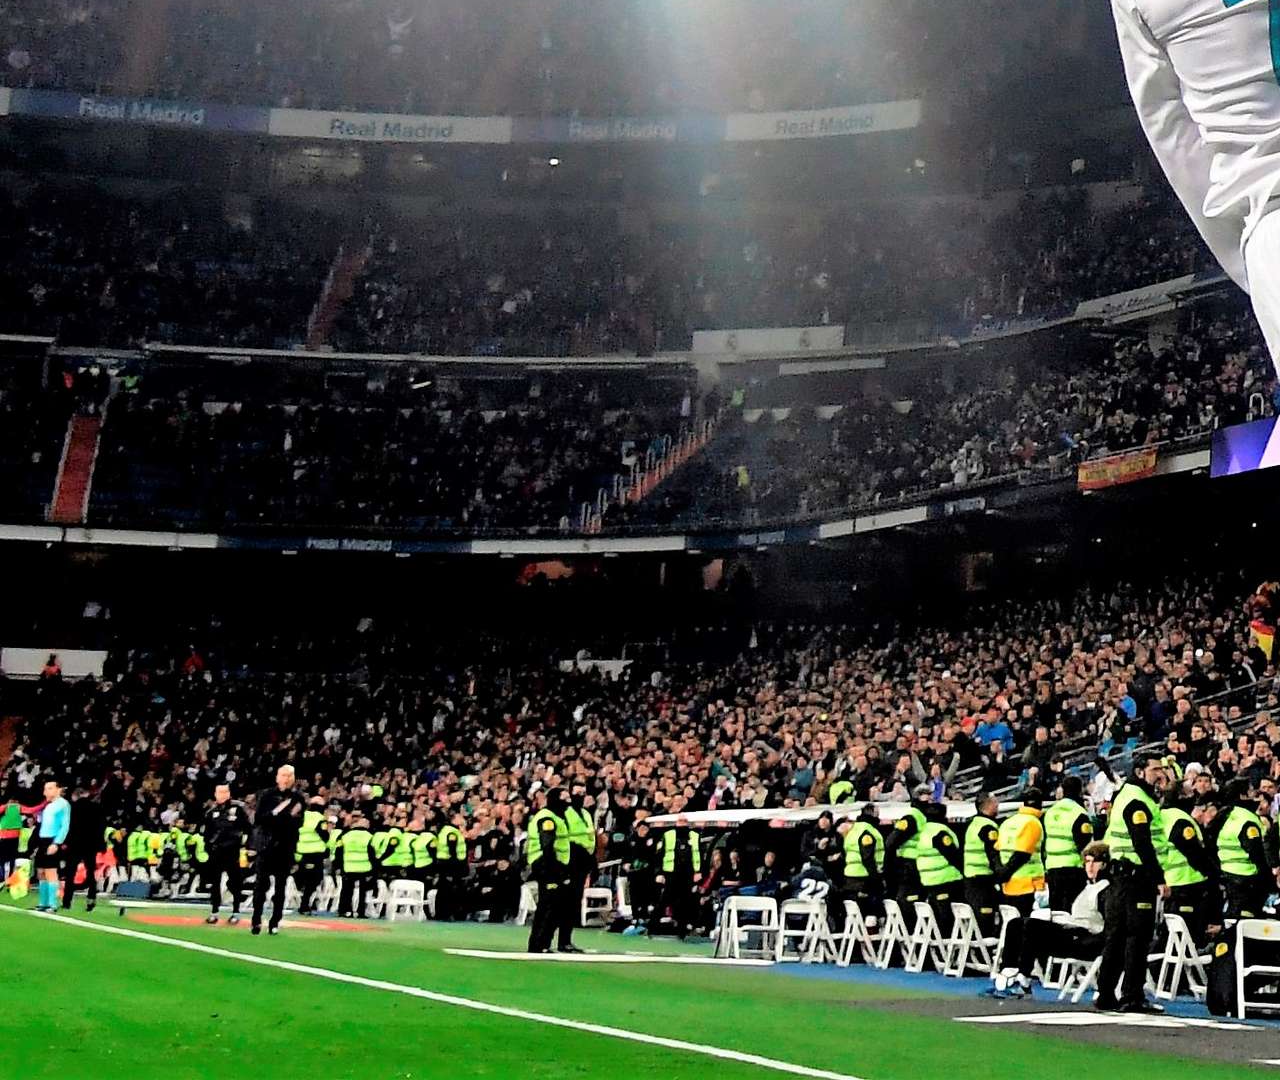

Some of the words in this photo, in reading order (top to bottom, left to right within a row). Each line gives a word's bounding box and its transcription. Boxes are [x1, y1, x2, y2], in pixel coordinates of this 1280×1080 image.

[79, 97, 125, 118] Real
[132, 102, 204, 124] Madrid
[330, 117, 376, 136] Real
[382, 121, 453, 138] Madrid
[775, 118, 815, 135] Real
[820, 114, 874, 133] Madrid
[799, 877, 830, 902] 22
